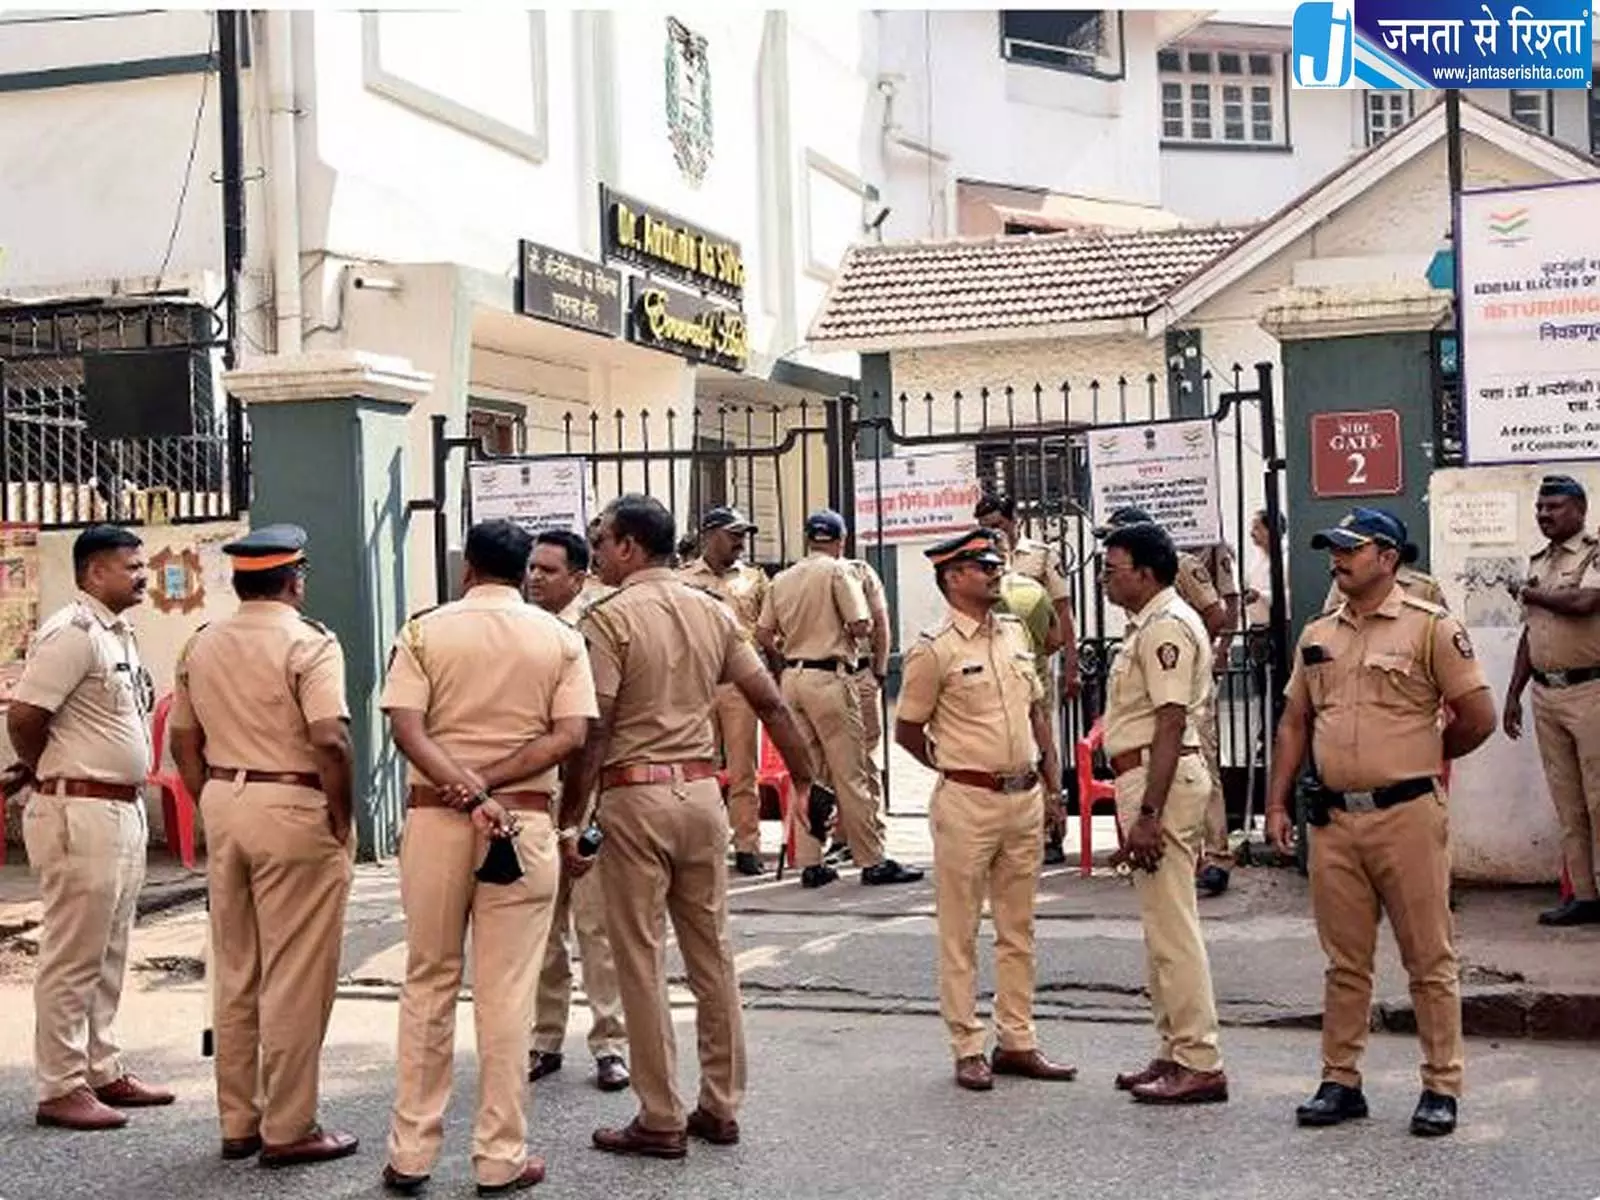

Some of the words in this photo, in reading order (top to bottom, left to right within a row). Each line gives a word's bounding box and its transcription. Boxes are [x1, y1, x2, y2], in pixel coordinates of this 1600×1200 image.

[1500, 425, 1552, 437] Address
[1329, 433, 1384, 451] GATE
[1511, 441, 1524, 453] of
[1346, 452, 1367, 484] 2
